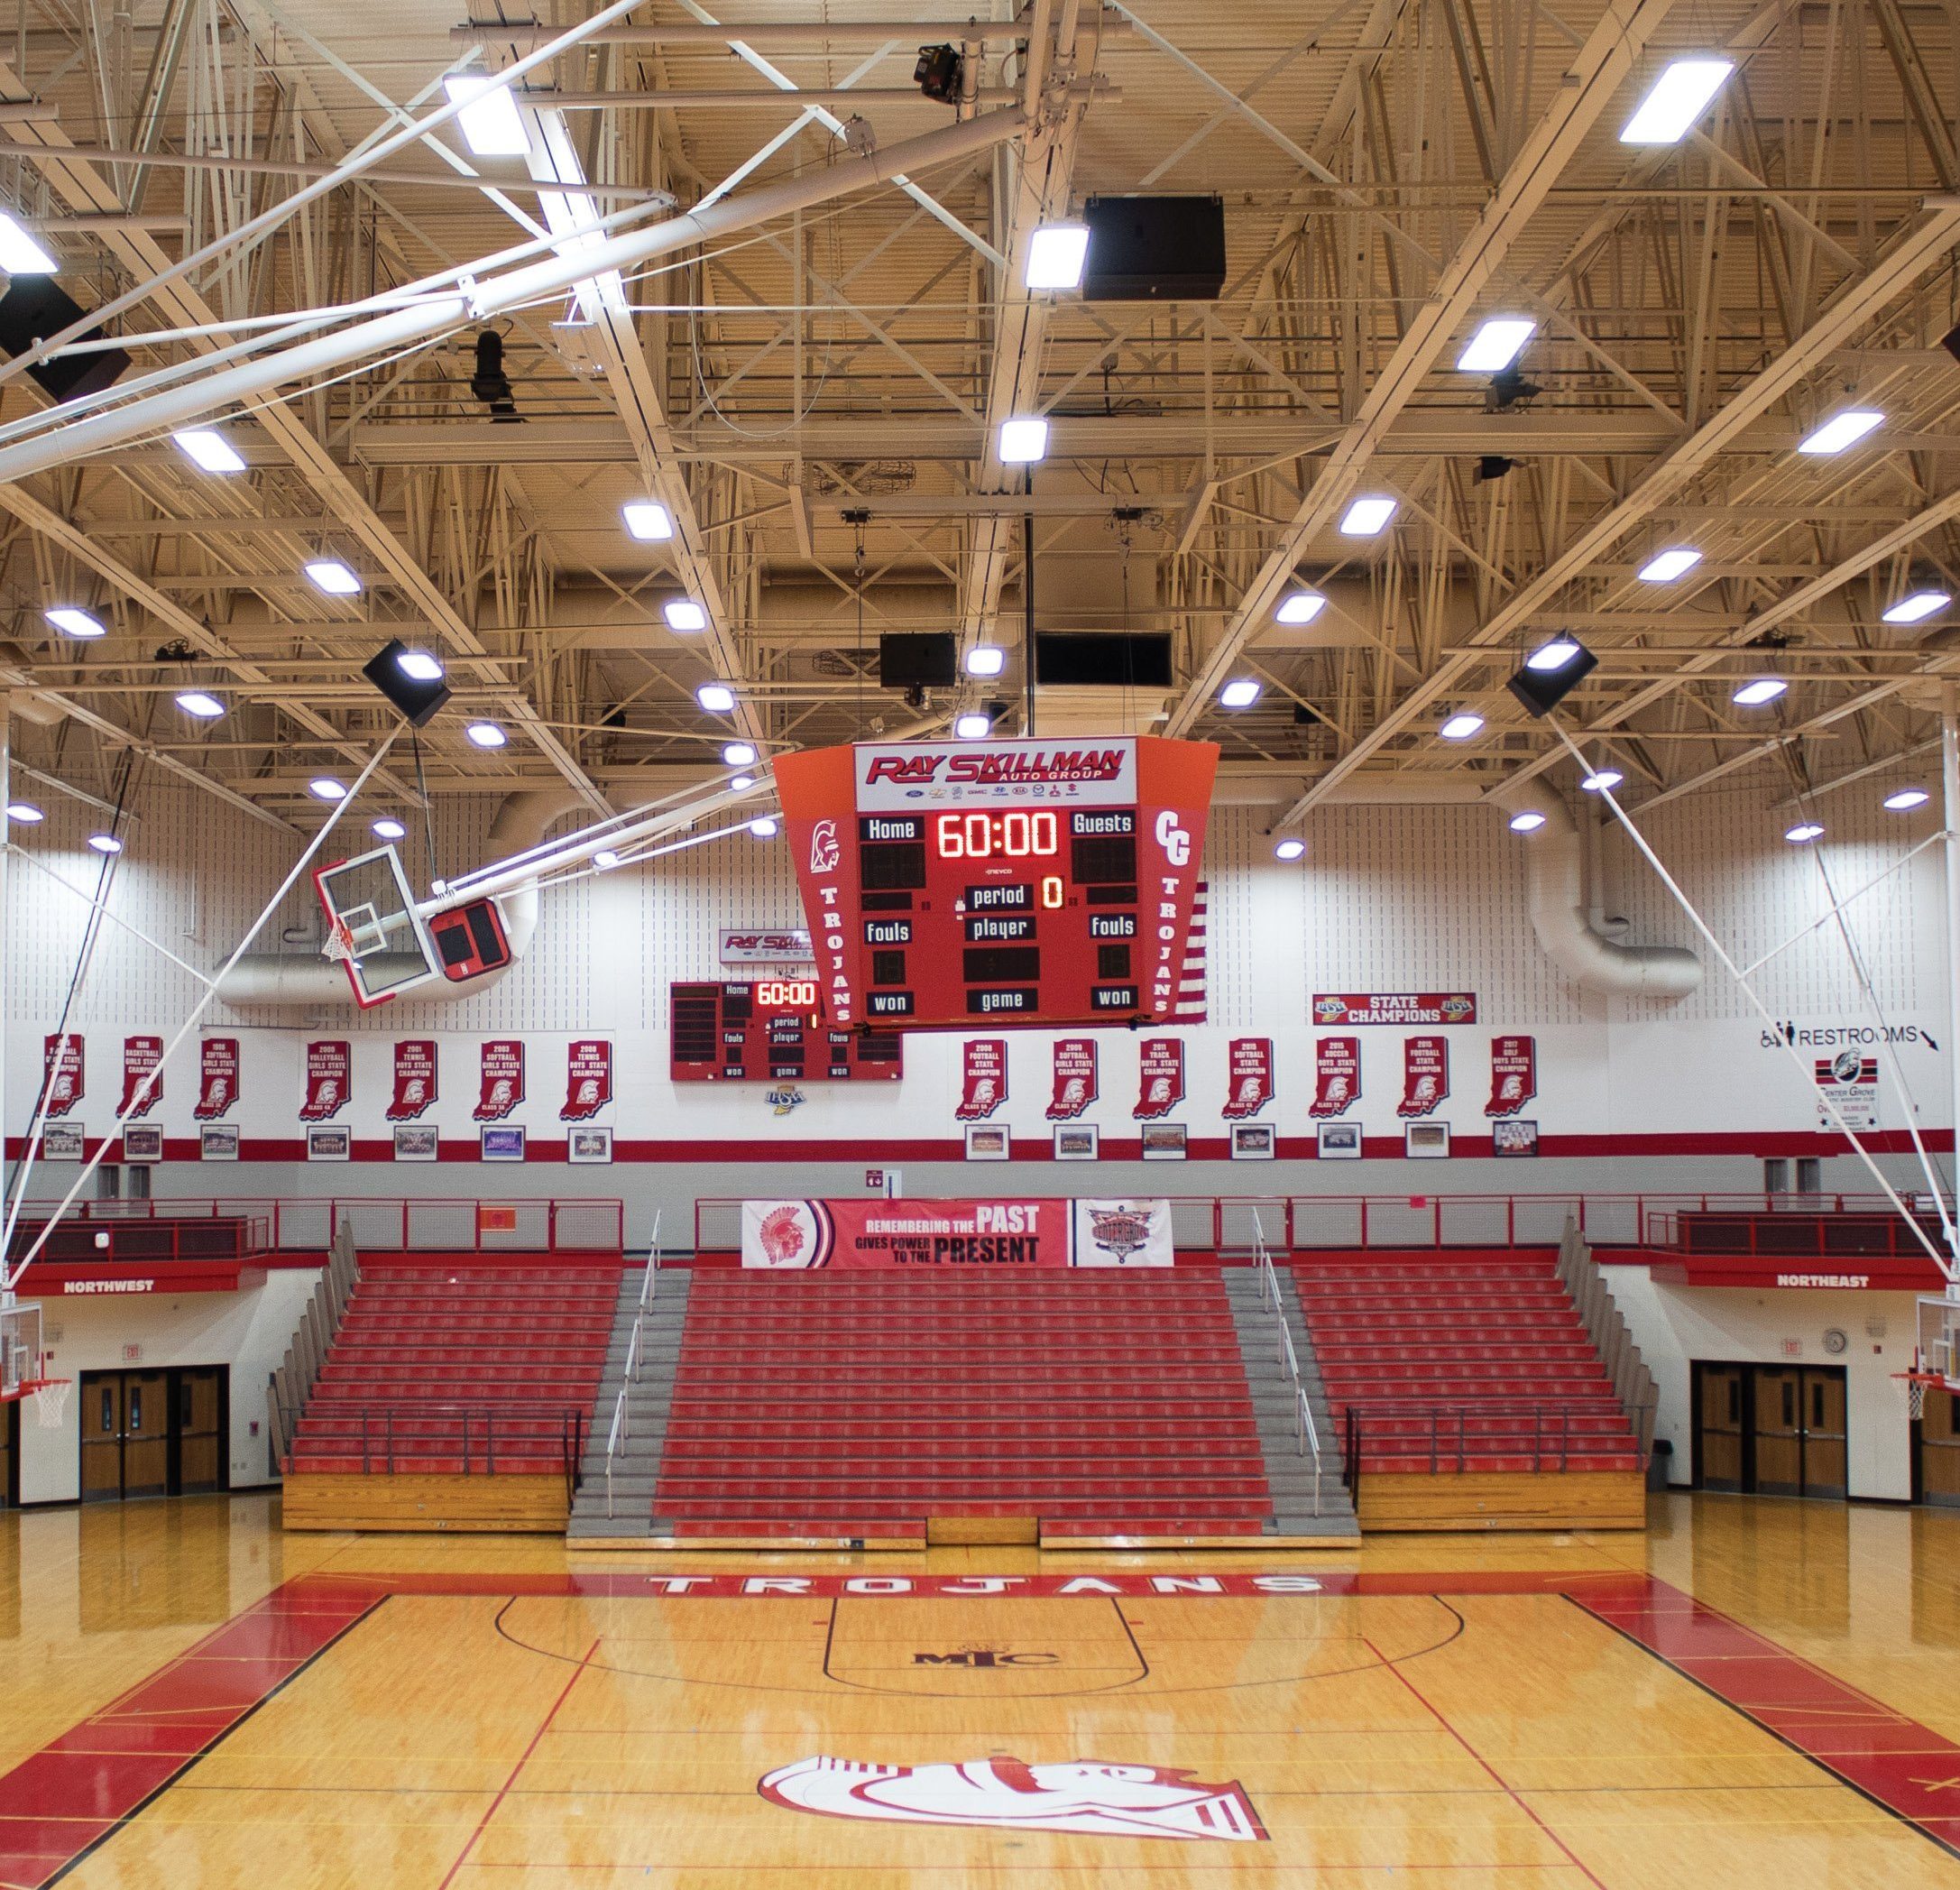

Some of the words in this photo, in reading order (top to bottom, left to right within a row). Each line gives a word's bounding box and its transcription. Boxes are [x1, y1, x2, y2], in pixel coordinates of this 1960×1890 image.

[866, 755, 947, 784] RAY
[945, 750, 1126, 782] SKILLMAN
[998, 771, 1040, 781] AUTO
[1048, 770, 1103, 780] GROUP
[869, 820, 915, 839] Home
[1073, 809, 1132, 834] Guests
[938, 812, 1057, 858] 60:00
[974, 885, 1025, 907] period
[1043, 877, 1063, 908] 0
[867, 922, 909, 942] fouls
[974, 918, 1027, 937] player
[1091, 917, 1134, 936] fouls
[1154, 878, 1180, 1013] TROJANS
[820, 887, 851, 1022] TROJANS
[726, 985, 749, 995] Home
[758, 983, 814, 1005] 60:00
[874, 997, 906, 1011] won
[981, 993, 1023, 1010] game
[1099, 991, 1130, 1006] won
[1370, 996, 1419, 1009] STATE
[774, 1018, 799, 1028] period
[1348, 1010, 1440, 1022] CHAMPIONS
[724, 1033, 743, 1043] fouls
[773, 1033, 799, 1043] player
[830, 1033, 849, 1043] fouls
[726, 1068, 742, 1076] won
[777, 1068, 796, 1077] game
[832, 1067, 848, 1075] won
[866, 1220, 950, 1233] REMEMBERING
[952, 1220, 974, 1233] THE
[977, 1205, 1040, 1233] PAST
[855, 1237, 888, 1249] GIVES
[890, 1237, 930, 1249] POWER
[934, 1237, 1040, 1263] PRESENT
[893, 1250, 907, 1262] TO
[911, 1250, 931, 1262] THE
[64, 1279, 154, 1294] NORTHWEST
[1777, 1275, 1870, 1287] NORTHEAST
[648, 1576, 1323, 1593] TROJANS
